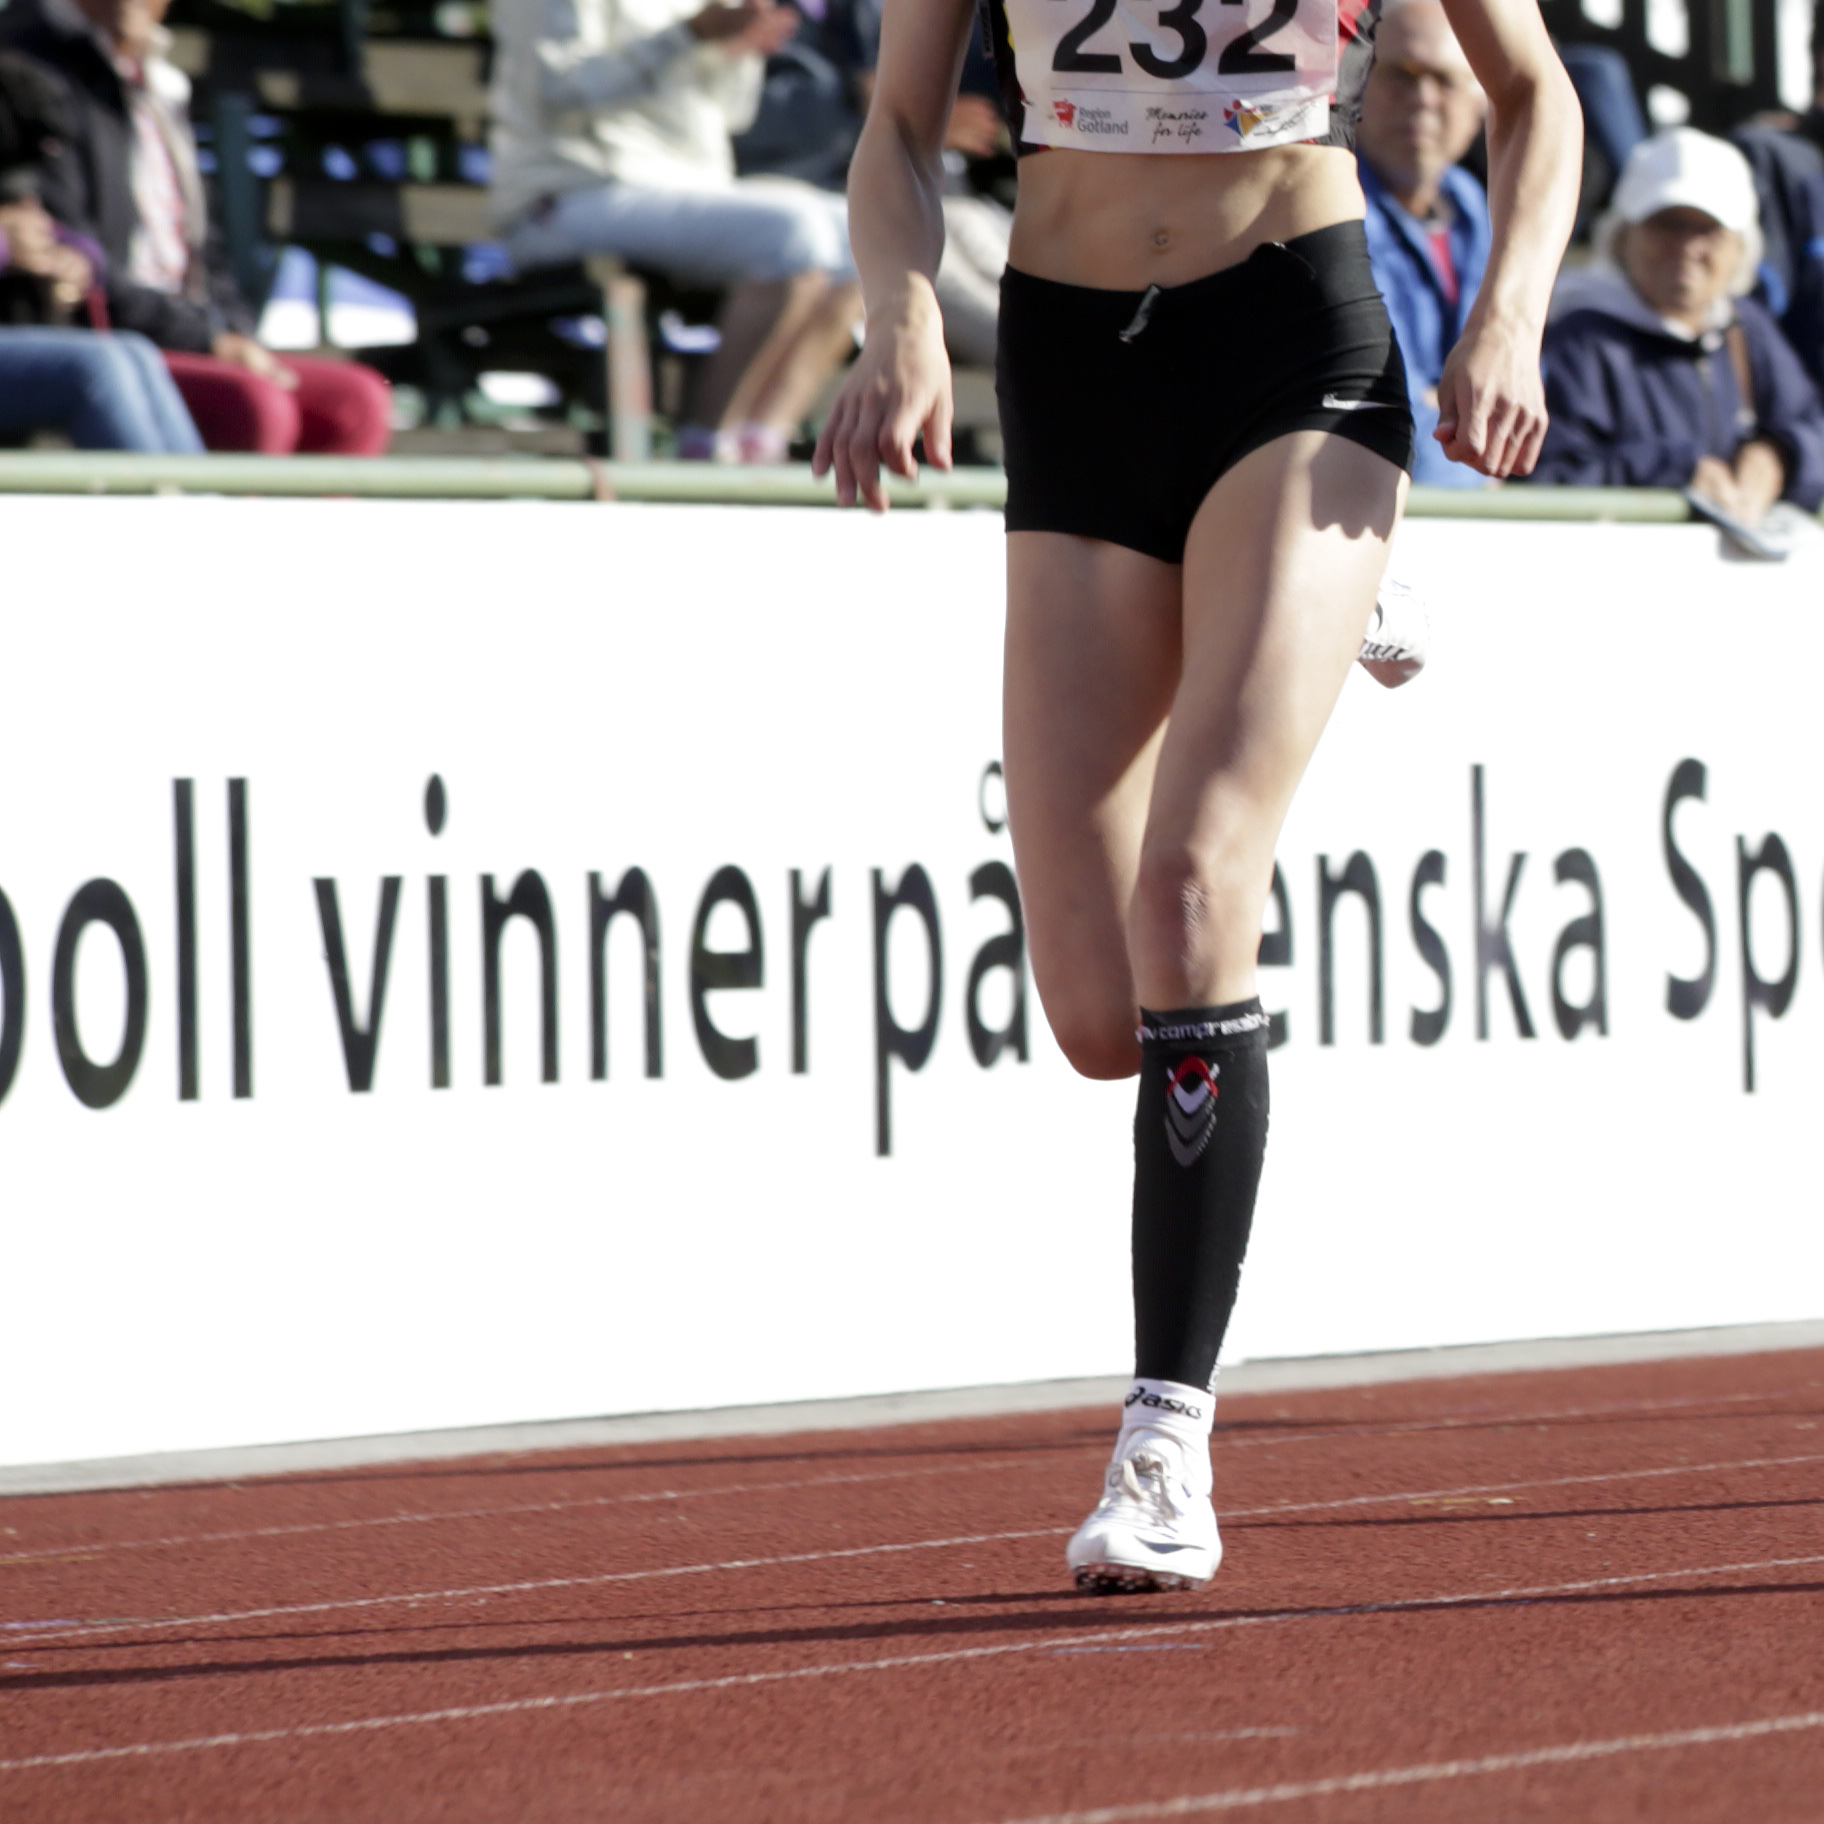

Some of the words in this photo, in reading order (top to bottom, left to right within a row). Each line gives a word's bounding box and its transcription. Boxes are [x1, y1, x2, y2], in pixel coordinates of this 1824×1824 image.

[1079, 107, 1112, 122] Region
[1144, 107, 1209, 123] Memories
[1077, 120, 1129, 136] Gotland
